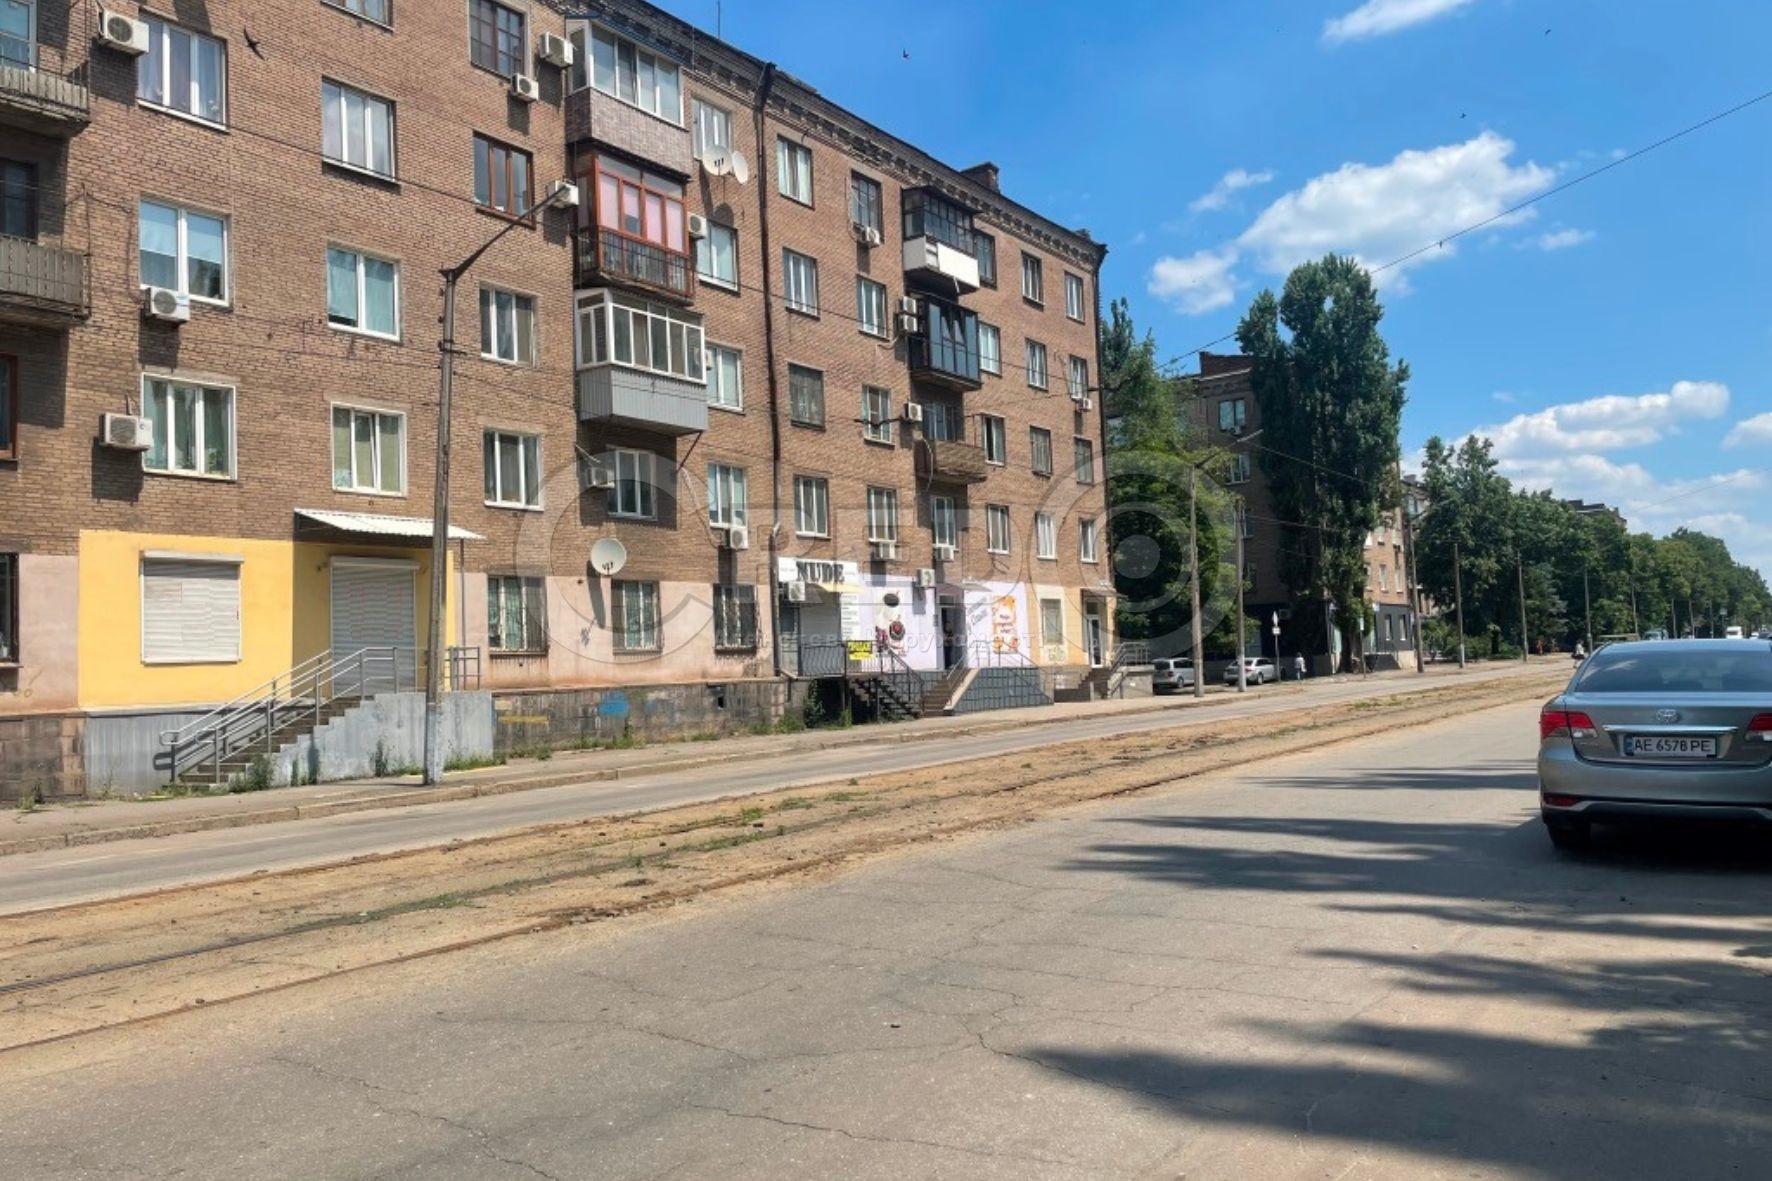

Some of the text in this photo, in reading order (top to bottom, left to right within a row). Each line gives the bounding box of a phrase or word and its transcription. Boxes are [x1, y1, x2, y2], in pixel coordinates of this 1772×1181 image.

[1635, 739, 1711, 752] AE 6578 PE
